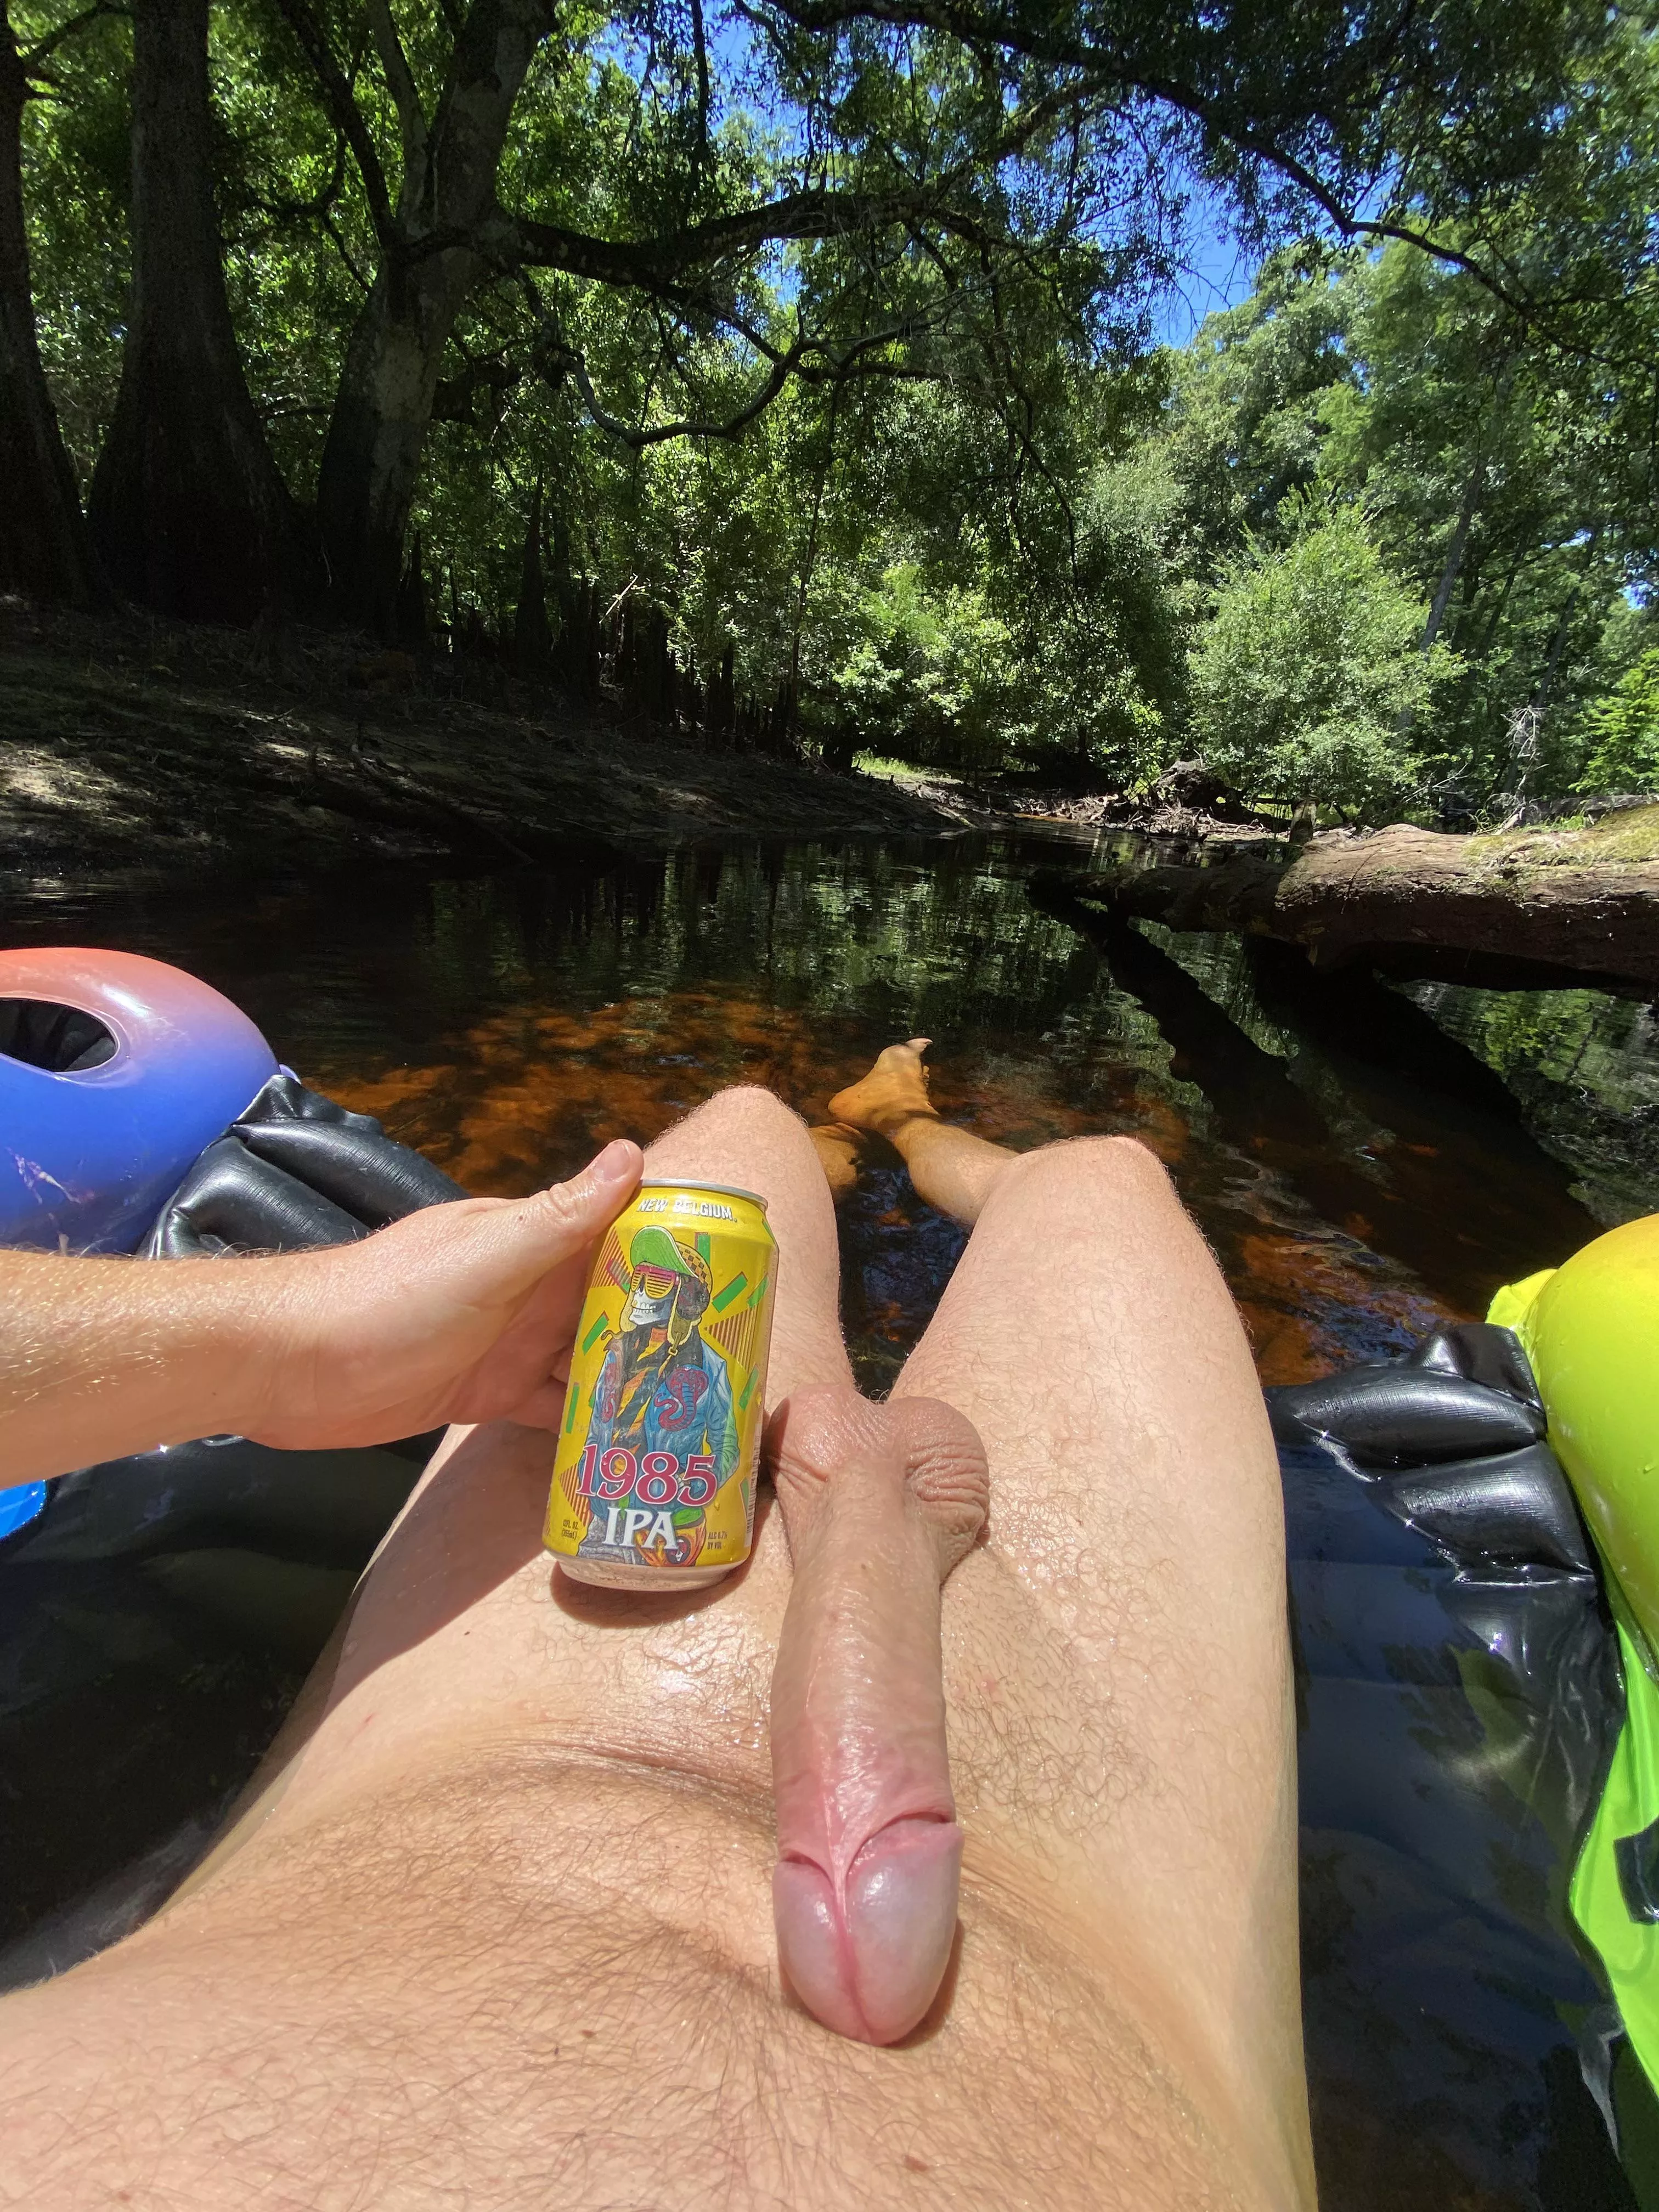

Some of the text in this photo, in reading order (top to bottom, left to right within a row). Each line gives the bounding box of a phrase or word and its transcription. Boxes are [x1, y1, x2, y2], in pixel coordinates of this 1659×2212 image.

[636, 1199, 668, 1212] NEW
[577, 1444, 718, 1506] 1985
[602, 1507, 678, 1550] IPA
